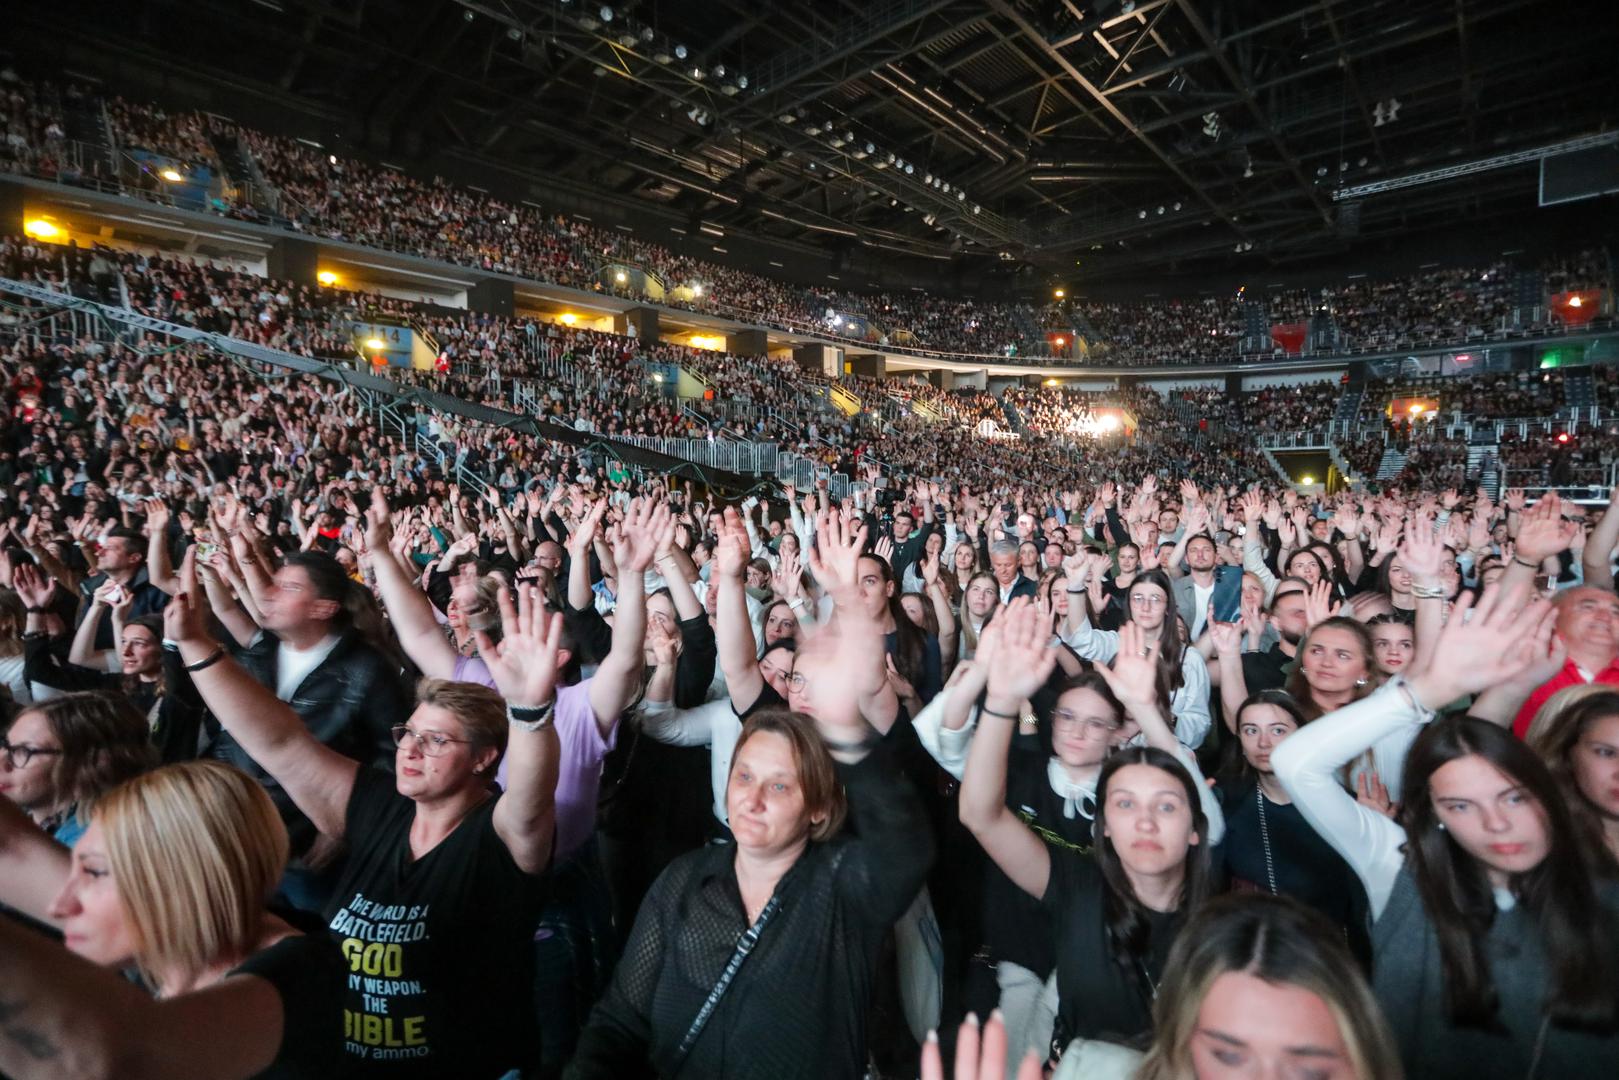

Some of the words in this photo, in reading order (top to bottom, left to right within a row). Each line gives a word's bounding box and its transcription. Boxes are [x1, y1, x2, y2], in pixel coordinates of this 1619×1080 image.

[348, 893, 372, 915] THE
[407, 905, 421, 920] IS
[329, 908, 430, 943] BATTLEFIELD.
[341, 937, 402, 977] GOD
[363, 977, 427, 995] WEAPON.
[362, 993, 388, 1014] THE
[344, 1041, 368, 1058] my
